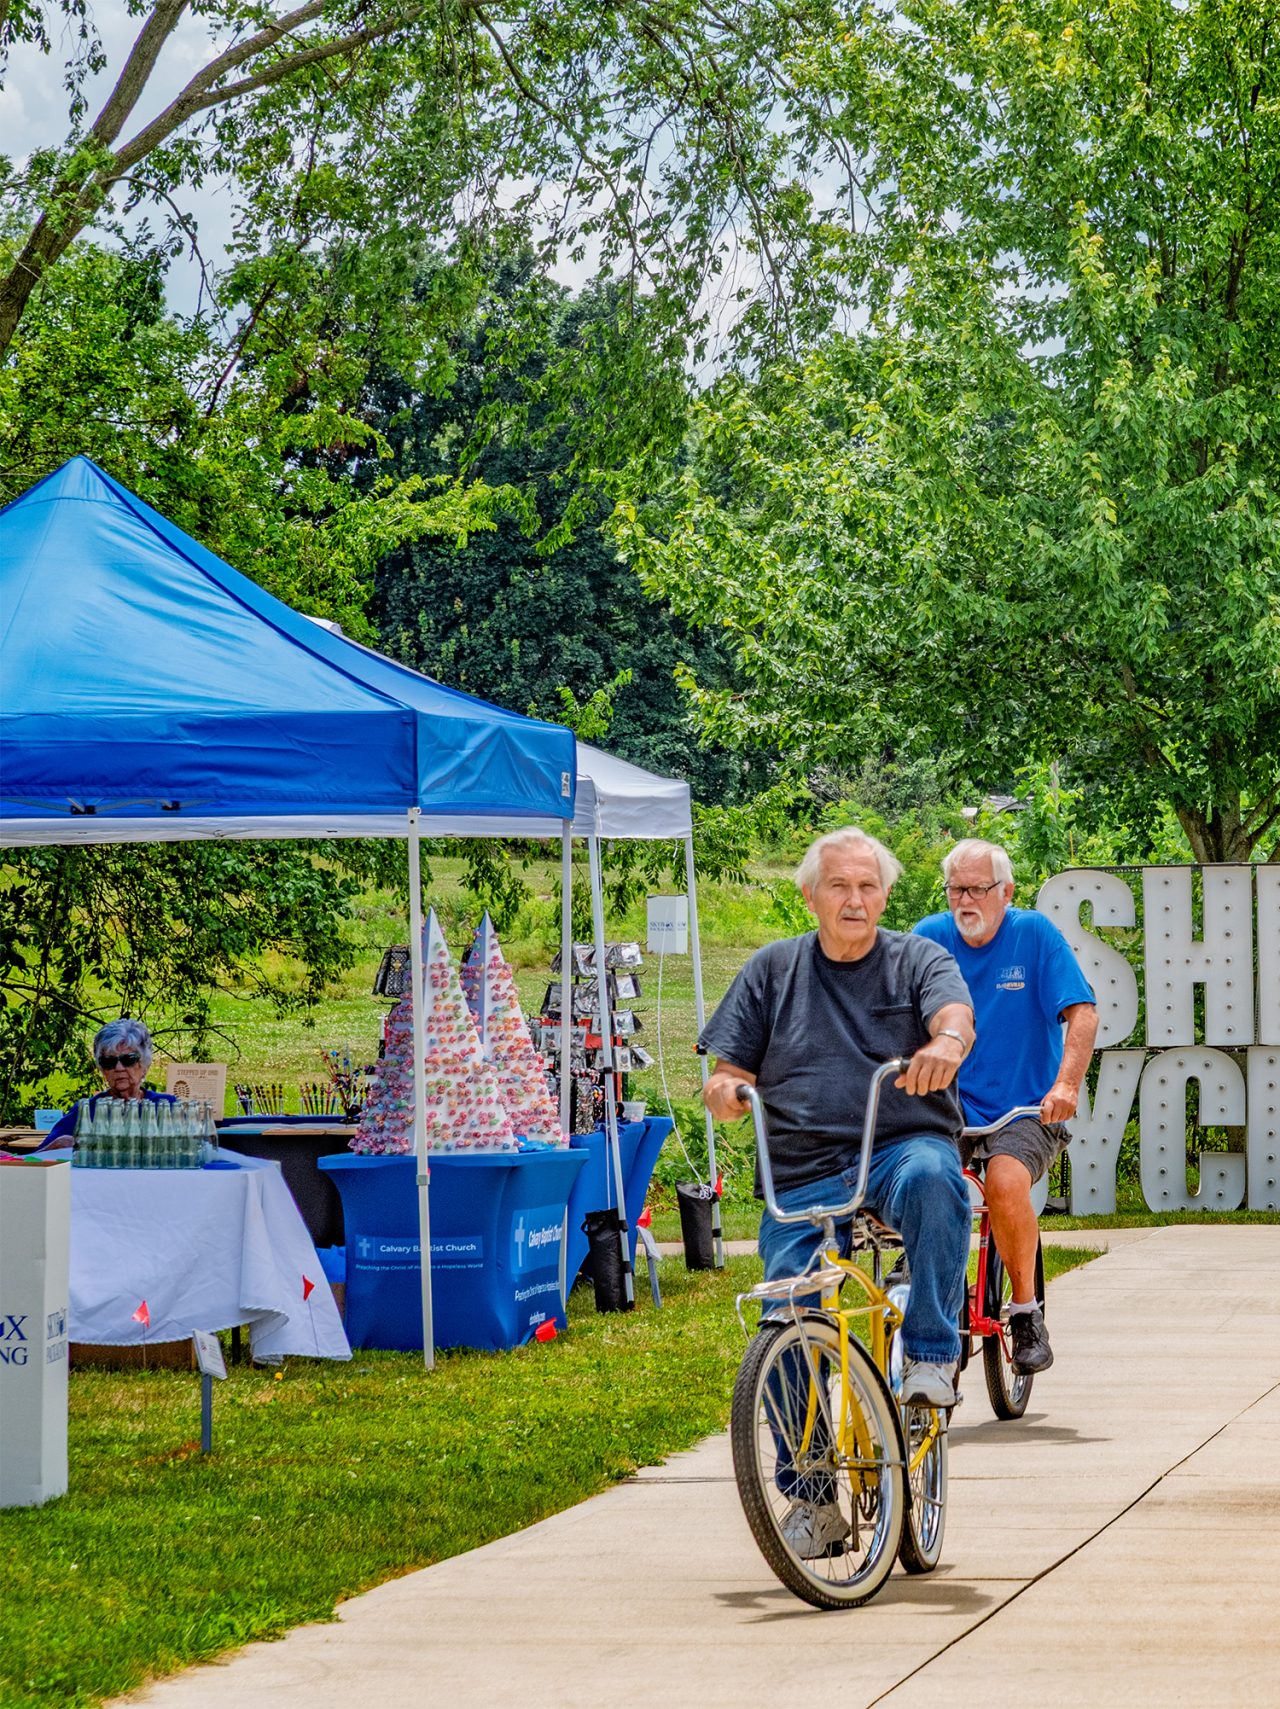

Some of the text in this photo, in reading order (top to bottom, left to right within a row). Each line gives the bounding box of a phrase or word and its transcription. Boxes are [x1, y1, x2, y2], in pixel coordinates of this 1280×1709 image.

[380, 1243, 477, 1254] Calvary Btist Church
